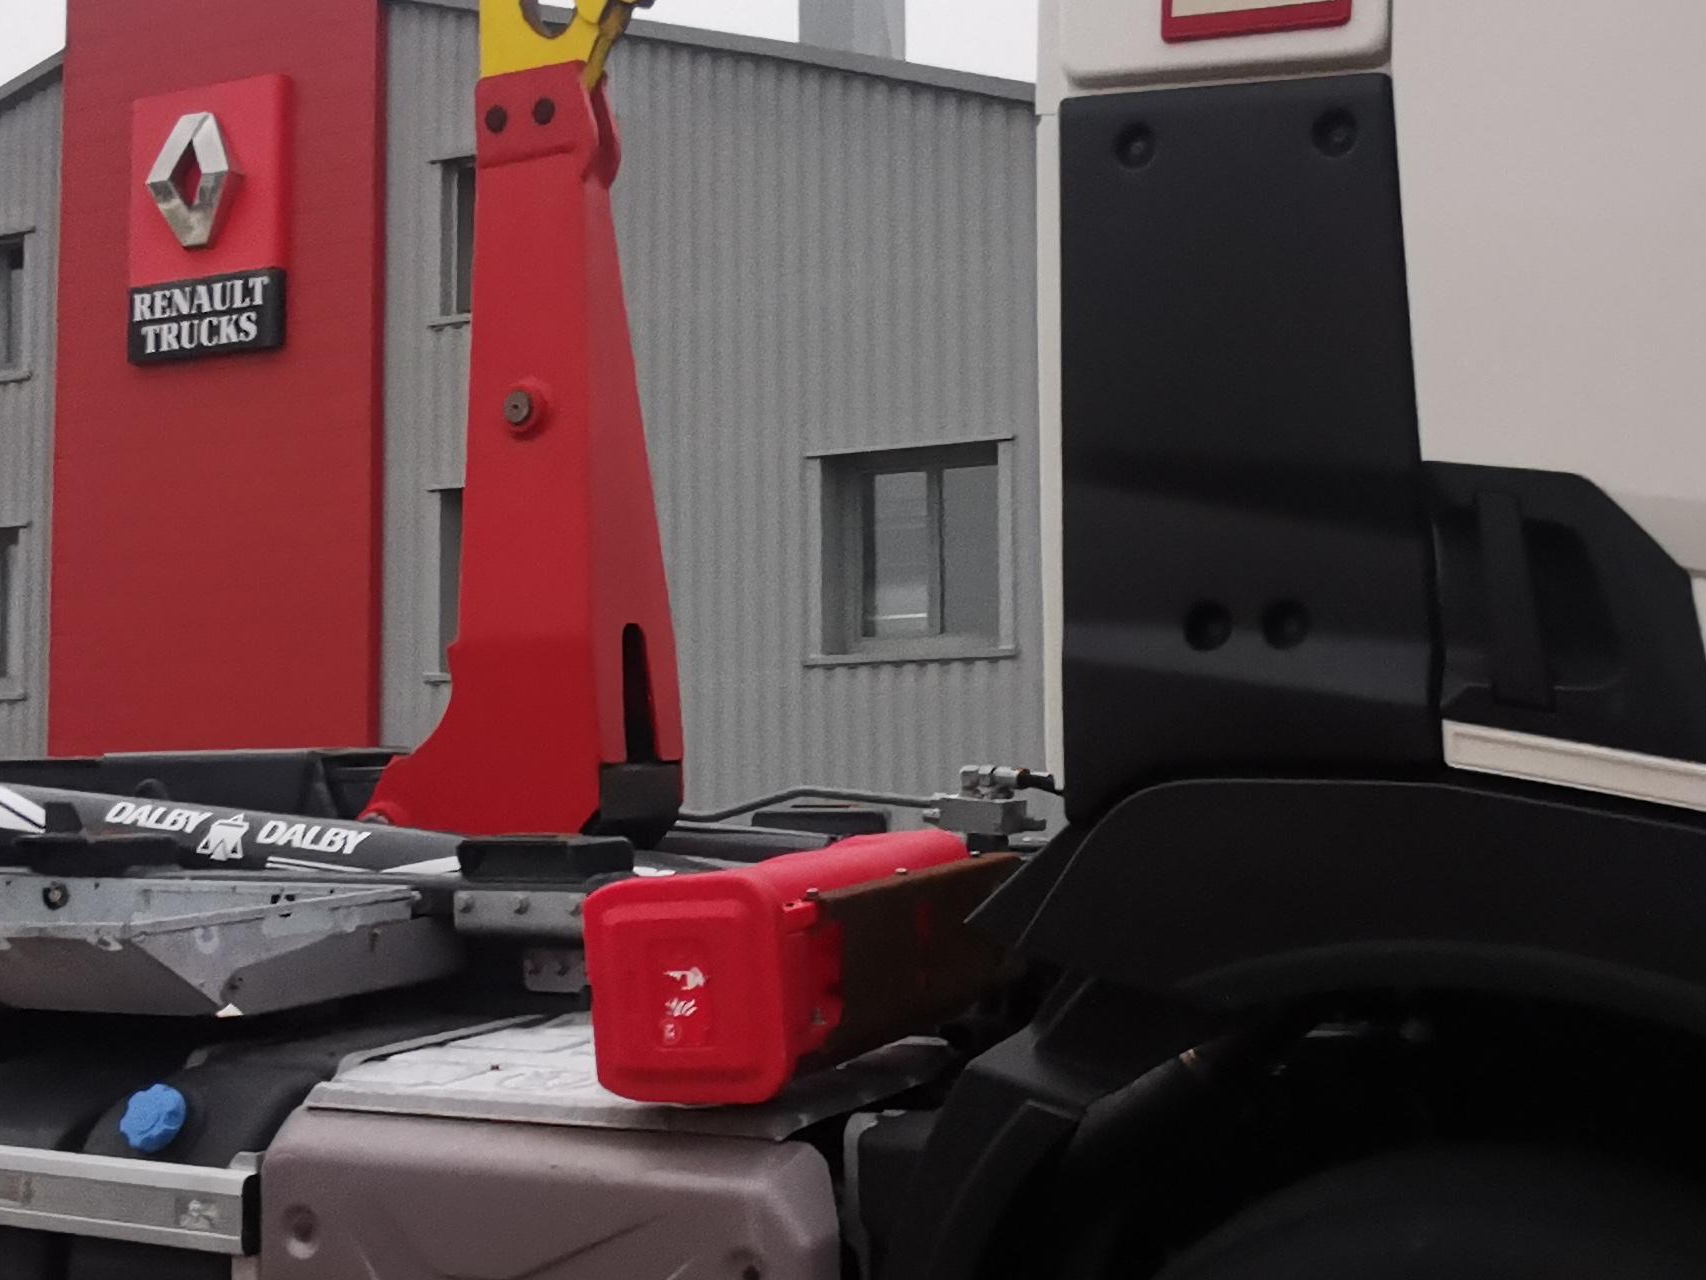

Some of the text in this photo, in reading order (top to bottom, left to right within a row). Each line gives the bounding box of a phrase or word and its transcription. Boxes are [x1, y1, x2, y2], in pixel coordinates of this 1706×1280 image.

[131, 275, 270, 322] RENAULT
[140, 310, 258, 354] TRUCKS
[104, 801, 372, 855] DALBY DALBY
